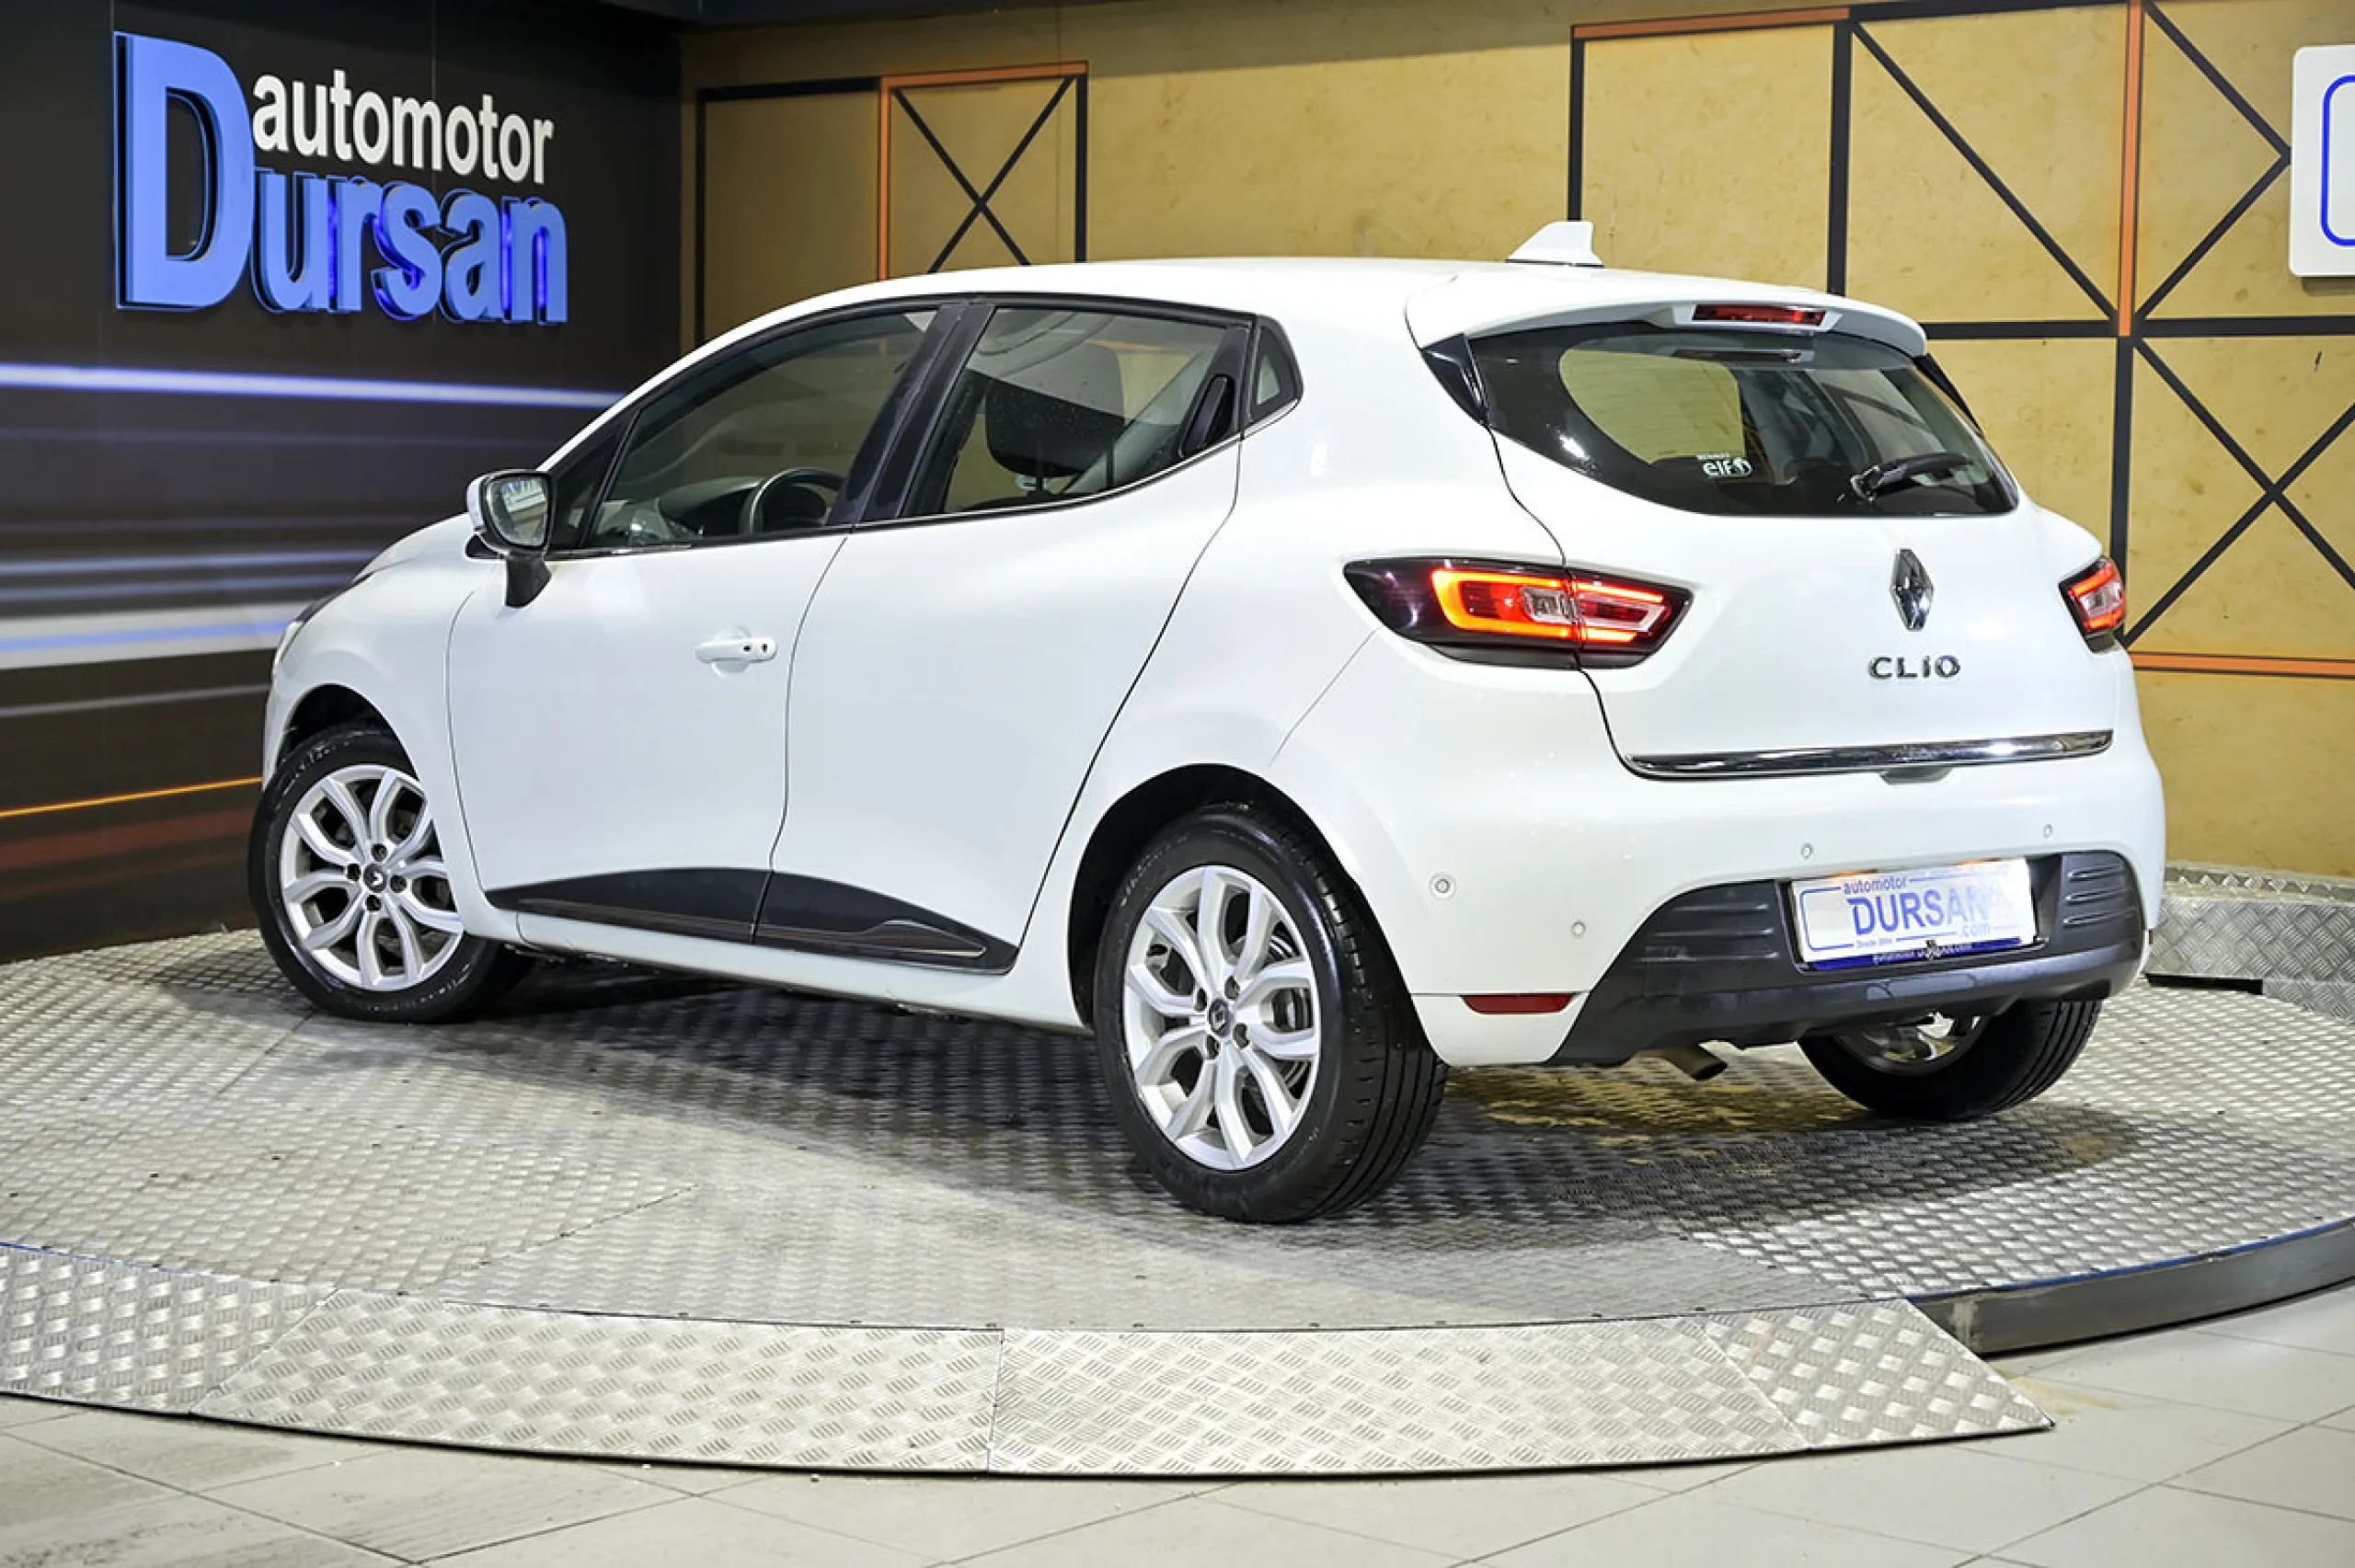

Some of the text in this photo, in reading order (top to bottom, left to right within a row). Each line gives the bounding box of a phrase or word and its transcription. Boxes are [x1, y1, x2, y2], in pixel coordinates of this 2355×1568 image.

[252, 69, 554, 184] automotor
[114, 31, 568, 325] Dursan
[1843, 876, 1907, 895] automotor
[1846, 887, 1989, 935] DURSAN
